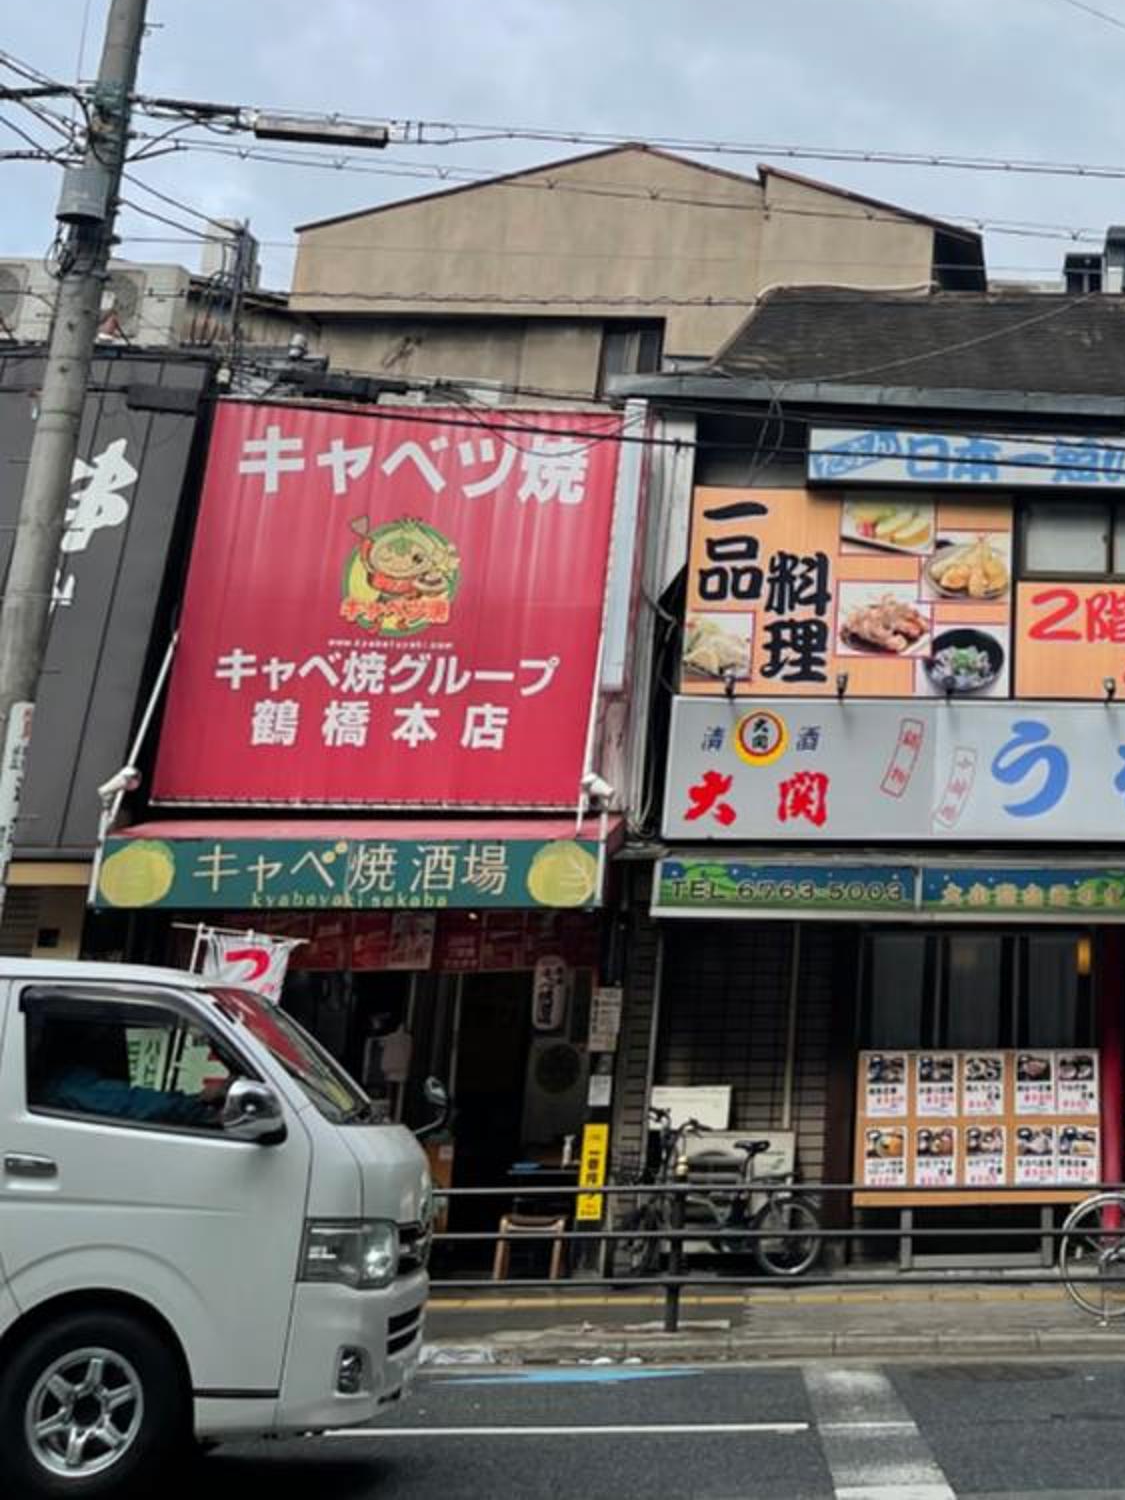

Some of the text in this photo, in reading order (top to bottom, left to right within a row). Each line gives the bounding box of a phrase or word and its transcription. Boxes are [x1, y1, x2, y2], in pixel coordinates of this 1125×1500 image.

[238, 426, 589, 505] キャベツ焼
[214, 650, 560, 695] キャベ焼グループ
[251, 703, 509, 750] 鶴橋本店
[684, 769, 829, 827] 大関
[193, 843, 509, 895] キャベ焼酒場
[673, 879, 724, 901] TEL
